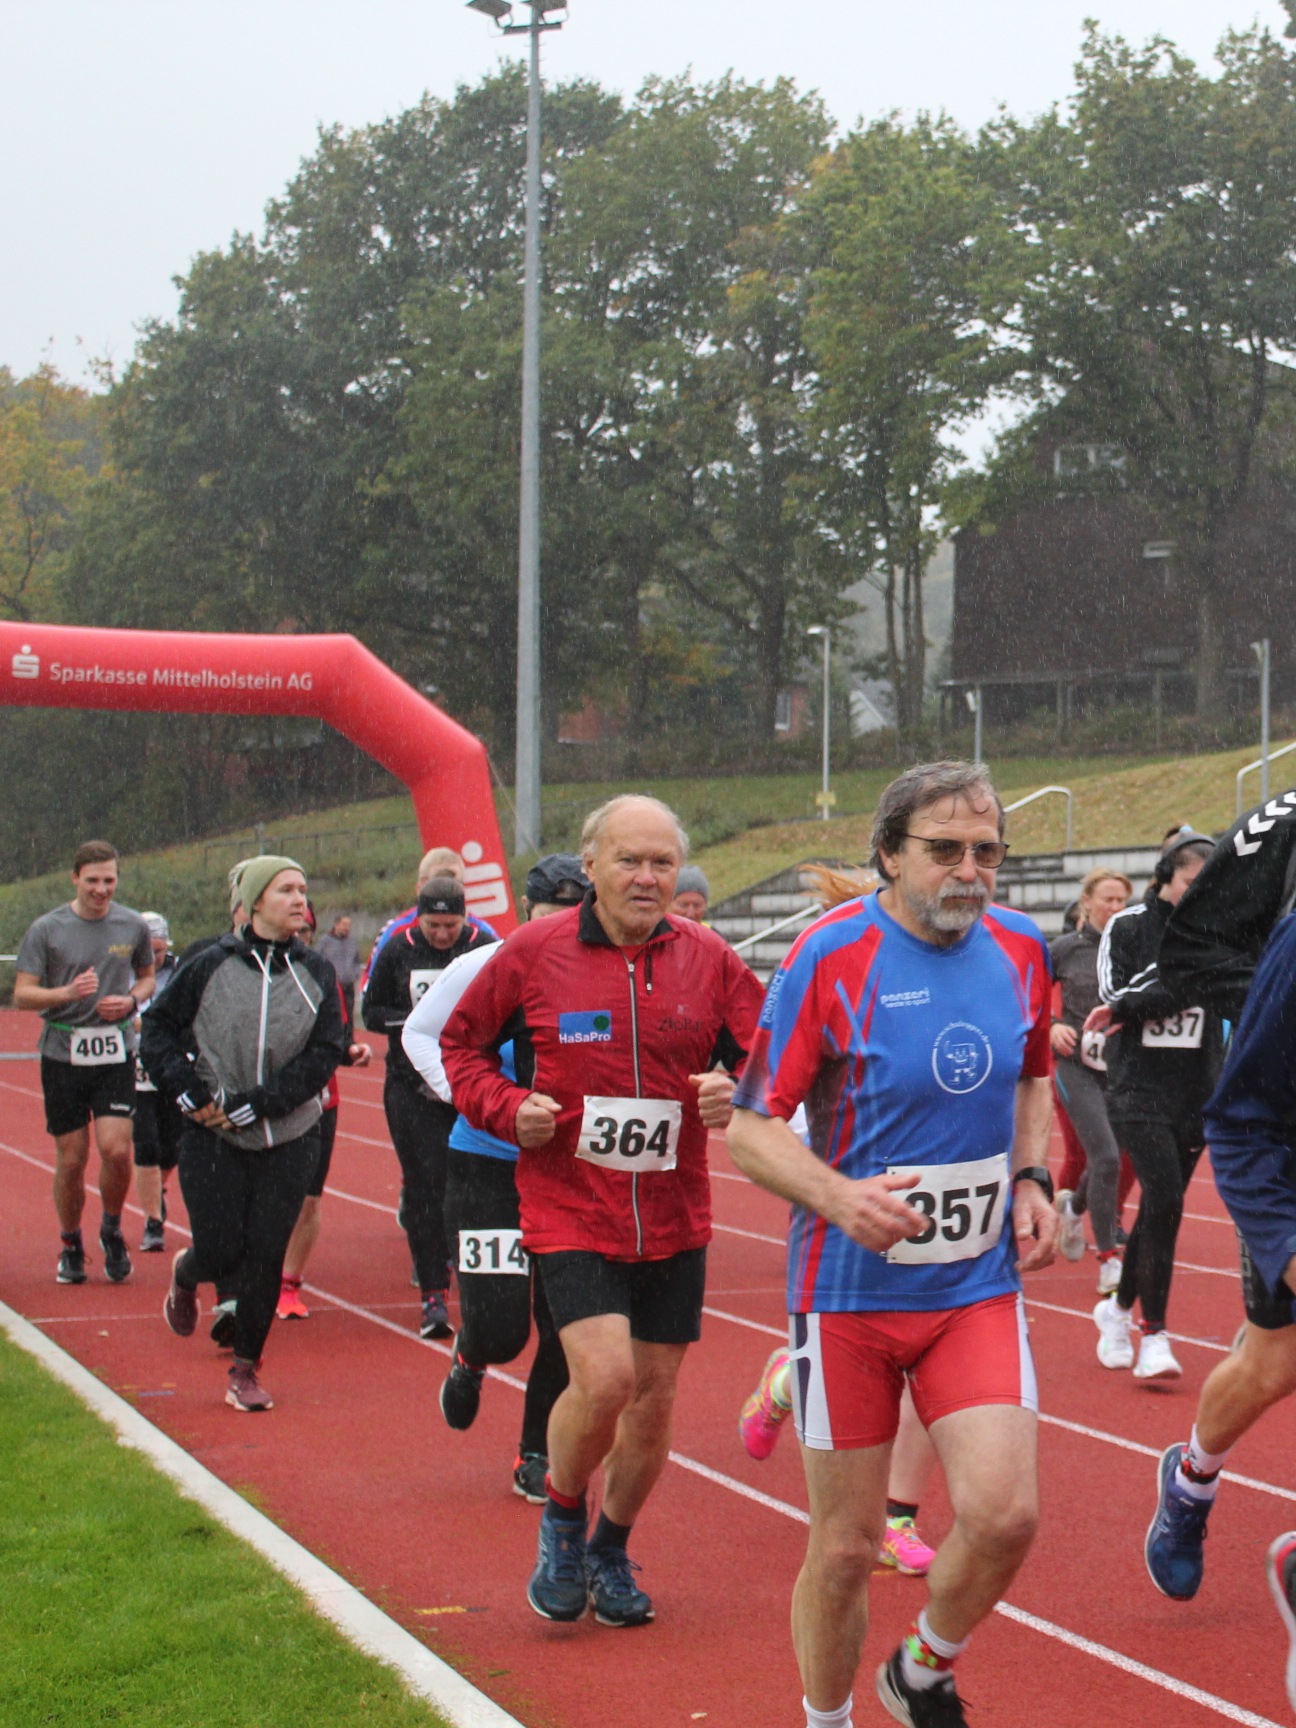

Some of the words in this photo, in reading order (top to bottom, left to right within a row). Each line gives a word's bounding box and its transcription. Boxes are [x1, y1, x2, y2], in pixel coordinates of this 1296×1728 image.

[49, 662, 148, 685] Sparkasse
[152, 667, 283, 690] Mittelholstein
[286, 672, 313, 691] AG
[559, 1032, 611, 1044] HaSaPro
[1149, 1012, 1200, 1037] 337
[76, 1034, 119, 1057] 405
[589, 1116, 670, 1158] 364
[904, 1180, 1000, 1245] 357
[465, 1236, 526, 1270] 314
